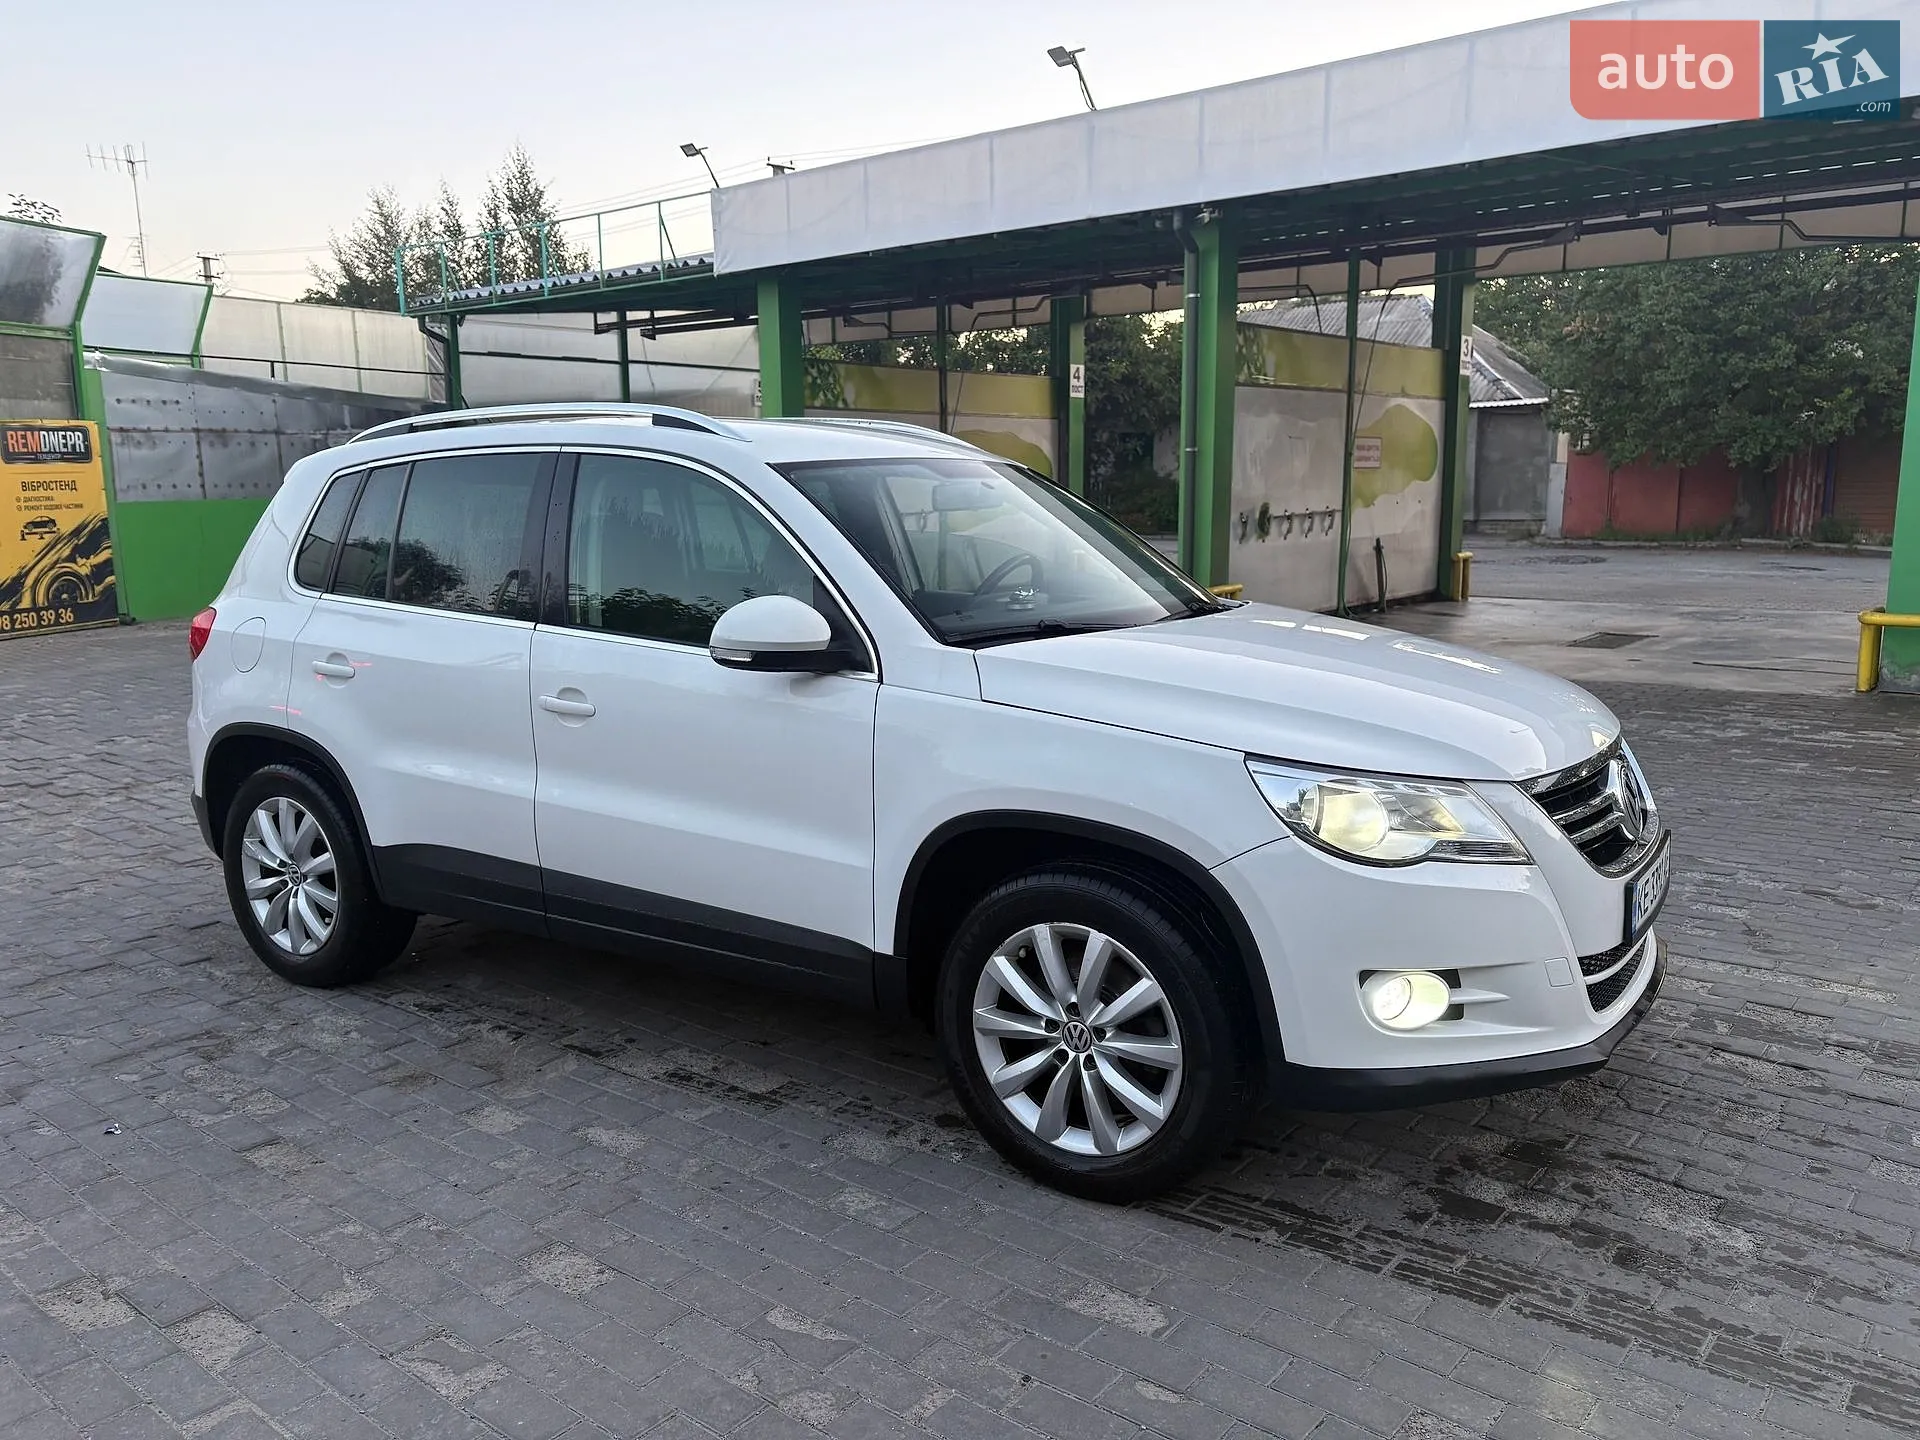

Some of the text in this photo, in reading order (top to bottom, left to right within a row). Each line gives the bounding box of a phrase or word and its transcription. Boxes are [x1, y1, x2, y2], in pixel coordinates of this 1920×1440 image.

[1463, 338, 1469, 357] 3
[1073, 367, 1081, 383] 4
[7, 431, 85, 452] REMDNEPR
[21, 480, 78, 492] ВІБРОСТЕНД
[0, 607, 75, 630] 8 250 39 36
[1063, 1021, 1092, 1053] VW
